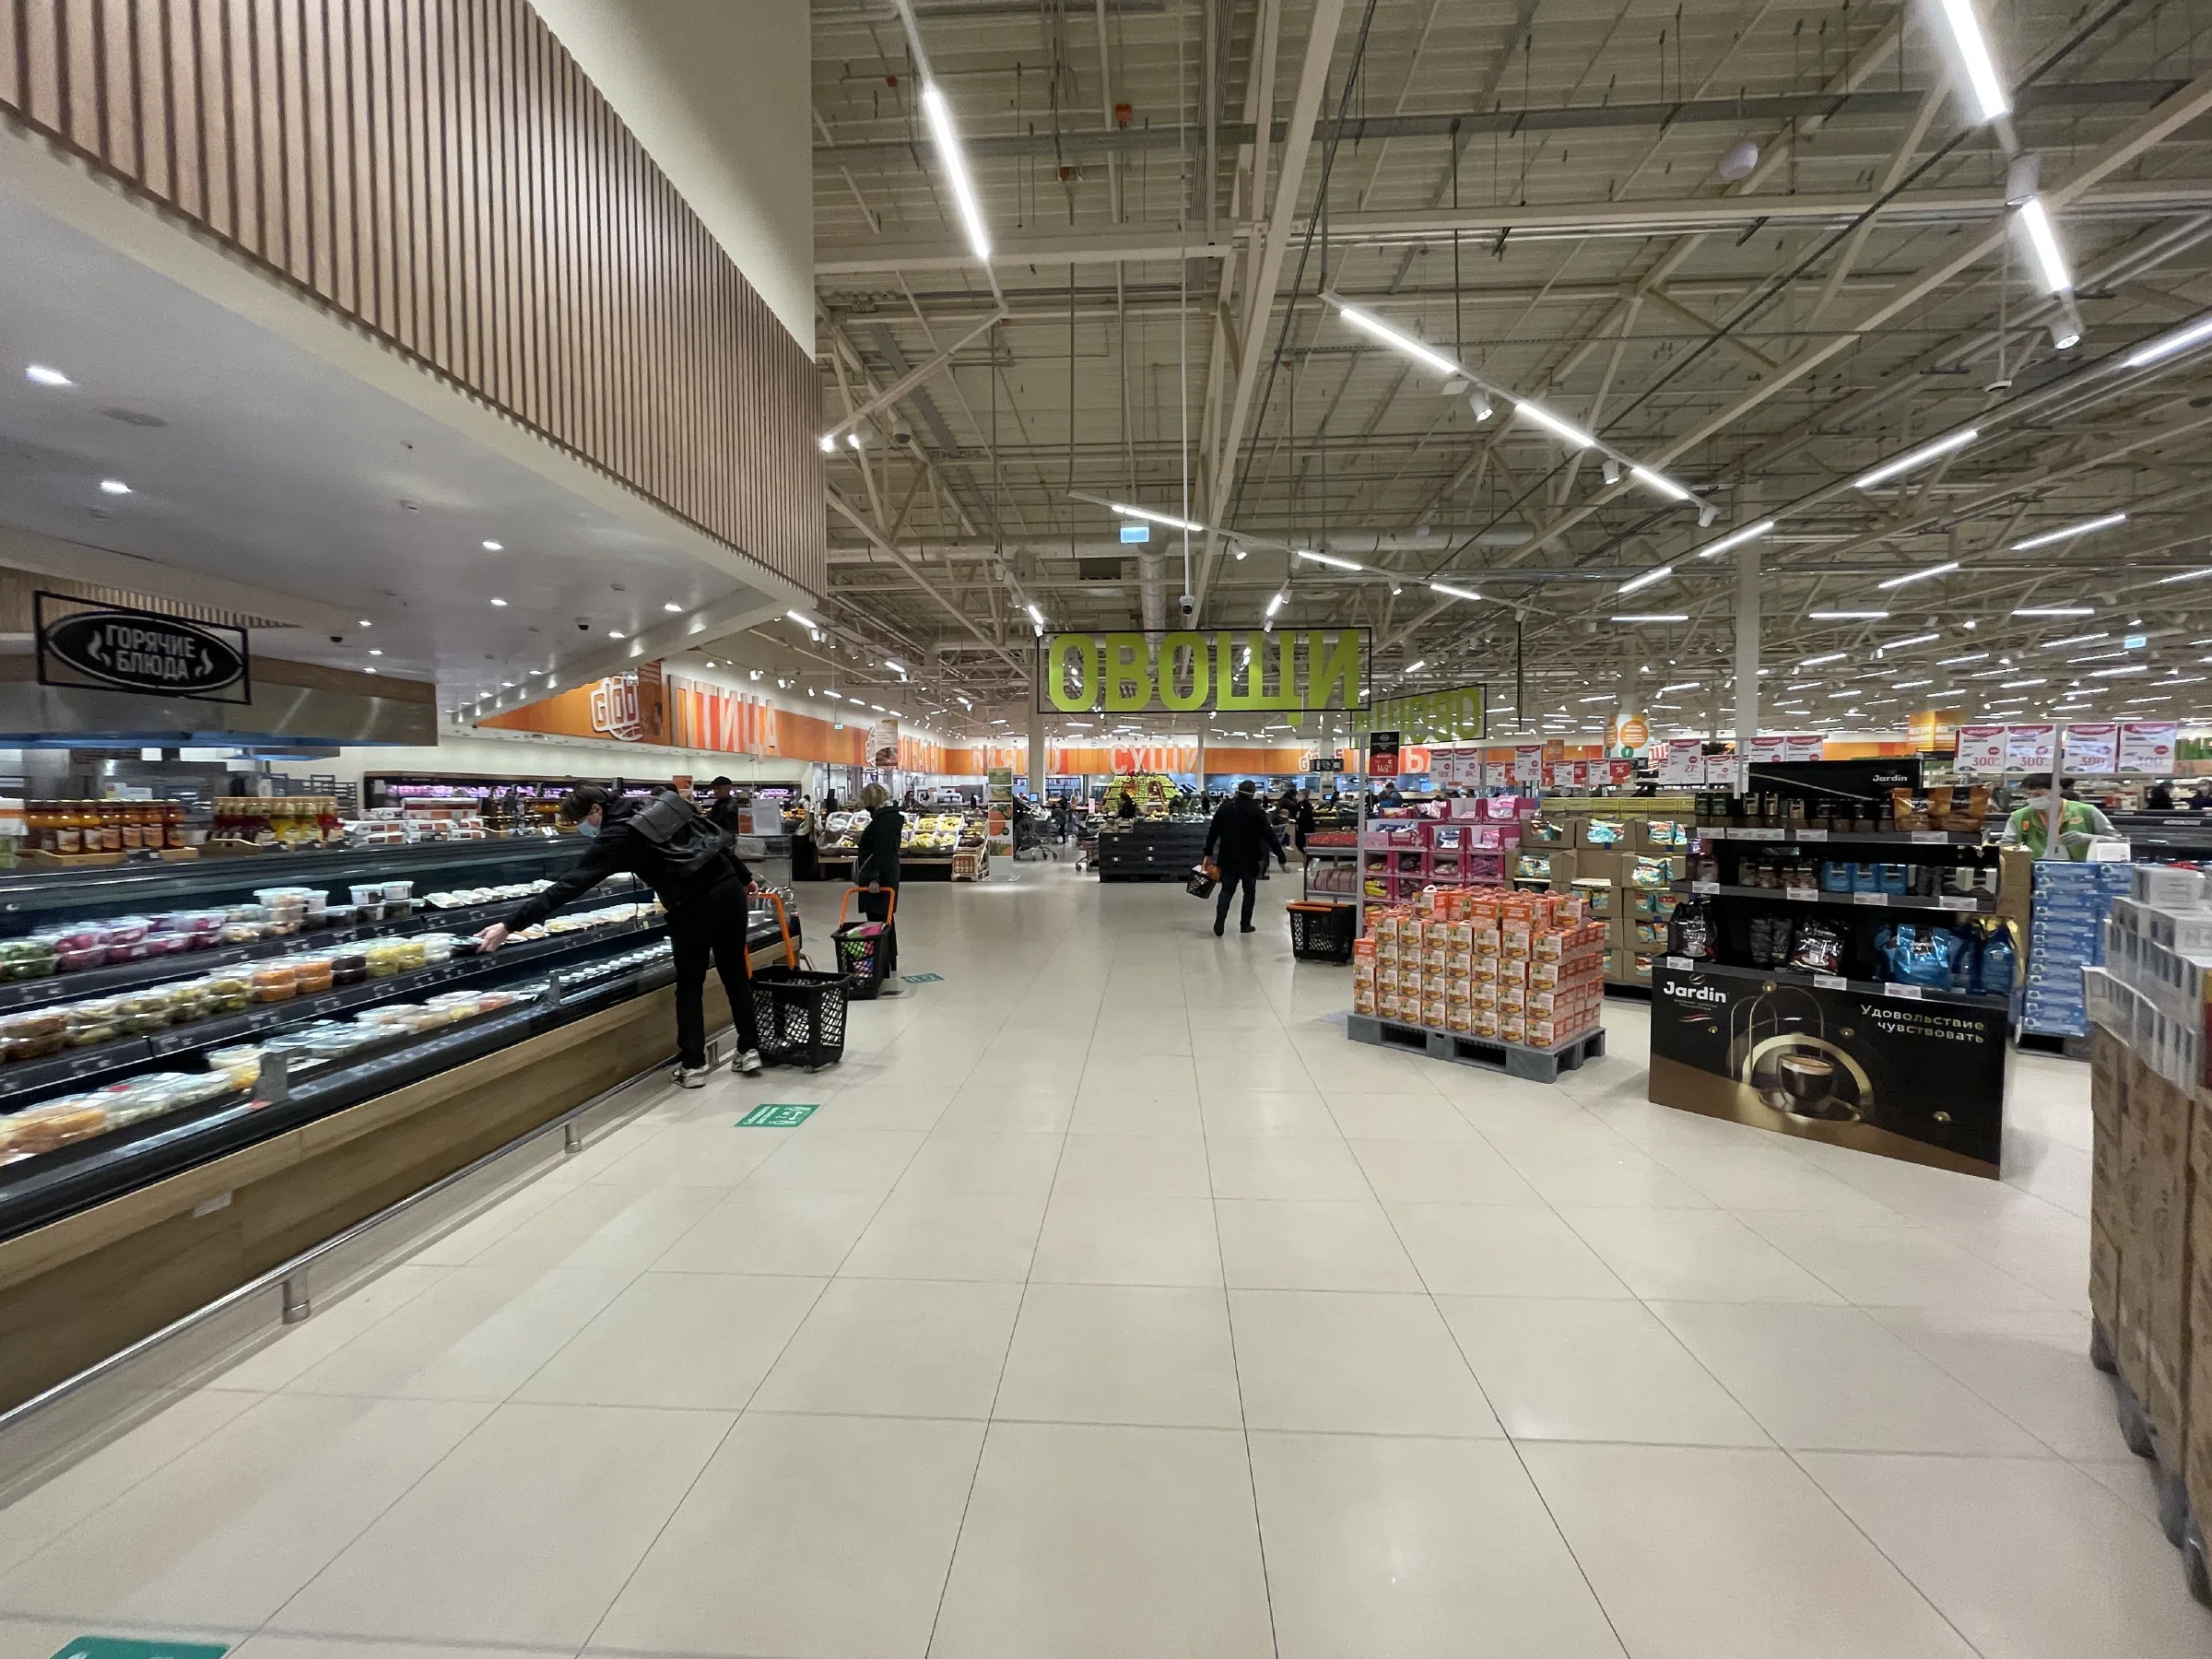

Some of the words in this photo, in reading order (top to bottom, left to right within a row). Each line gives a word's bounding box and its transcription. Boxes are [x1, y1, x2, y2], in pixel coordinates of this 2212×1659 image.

[105, 624, 195, 658] ГОРЯЧИЕ
[116, 650, 190, 681] БЛЮДА
[1049, 629, 1359, 726] ОВОЩИ
[667, 674, 781, 764] ПТИЦА
[1872, 774, 1908, 782] Jardin
[1663, 981, 1727, 1004] Jardin
[1860, 1004, 1984, 1030] Удовольствие
[1877, 1021, 1984, 1043] чувствовать
